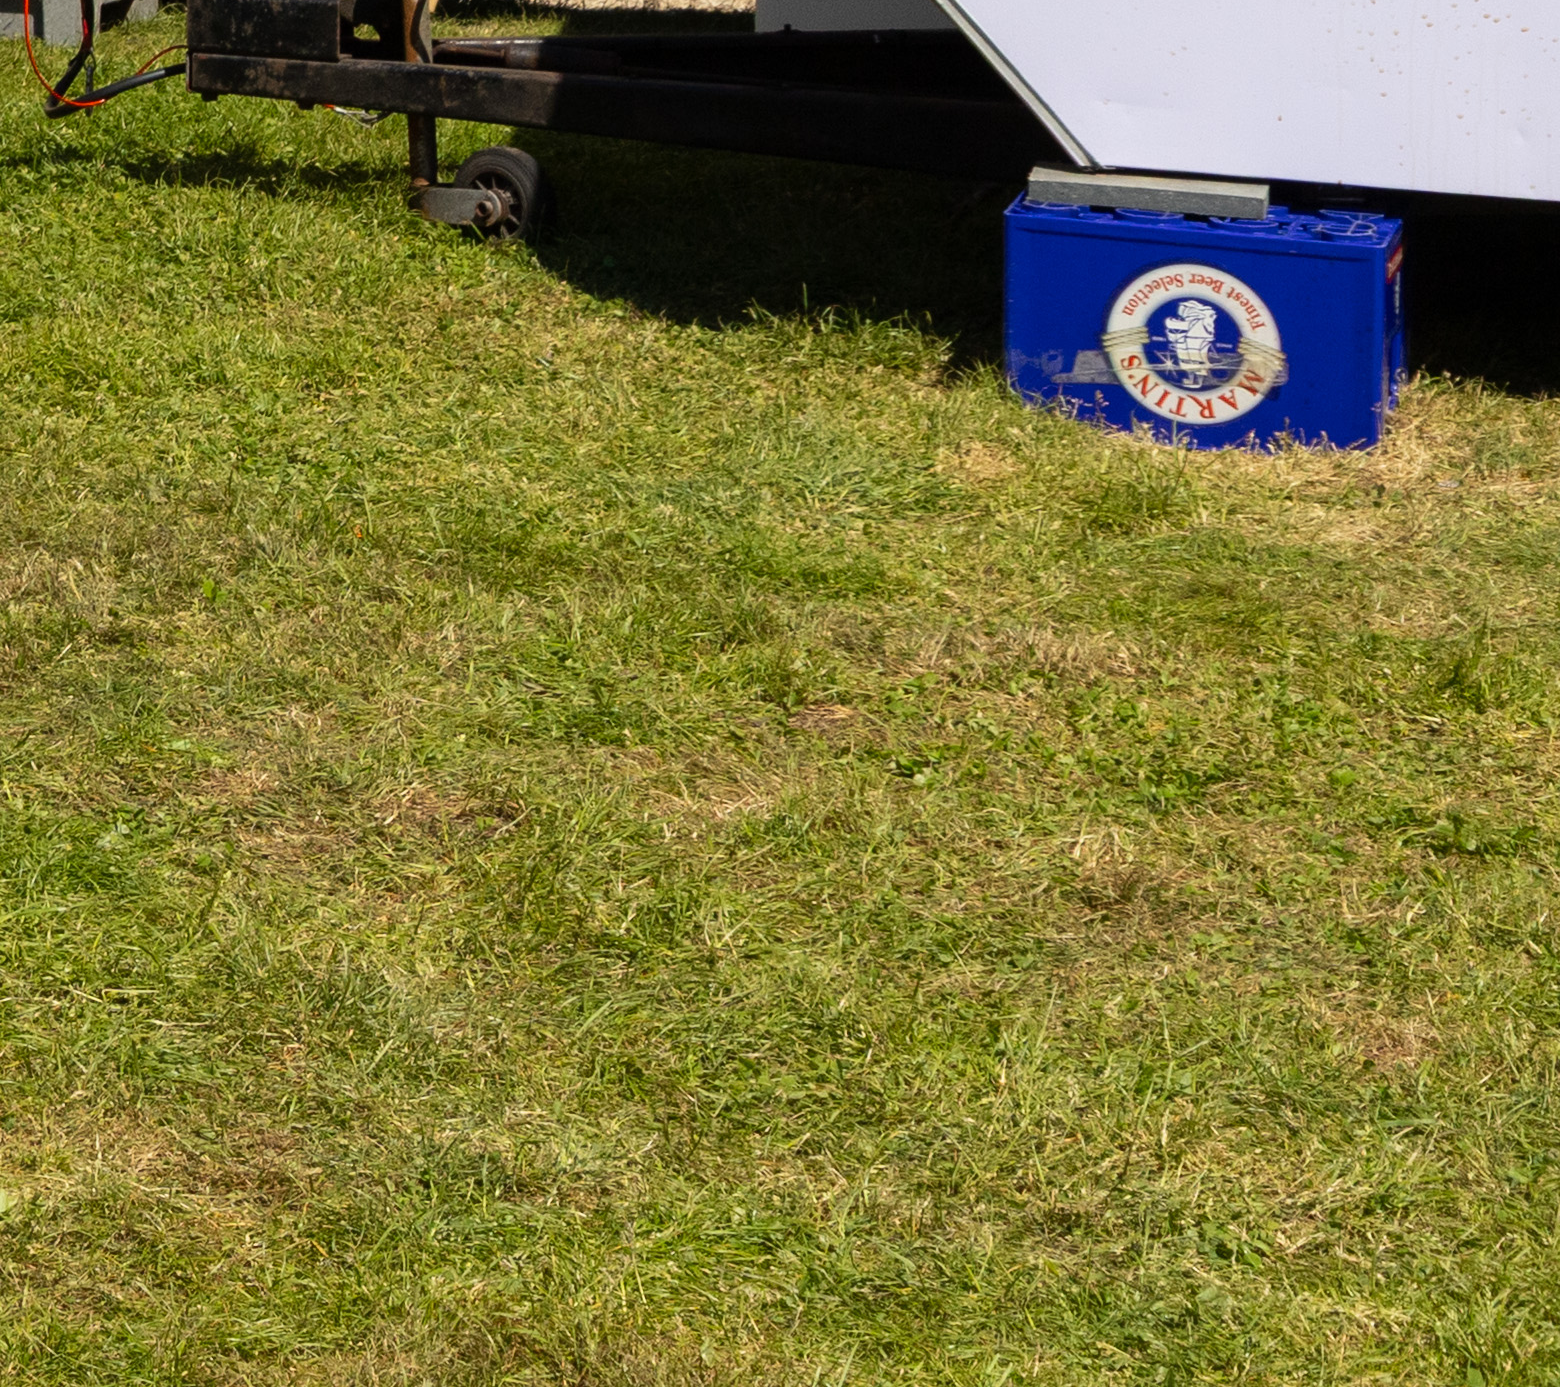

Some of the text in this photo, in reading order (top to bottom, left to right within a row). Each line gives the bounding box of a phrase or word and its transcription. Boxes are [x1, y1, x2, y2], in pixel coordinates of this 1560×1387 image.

[1121, 273, 1267, 331] Finest Beer Selection
[1120, 354, 1265, 420] MARTIN'S
